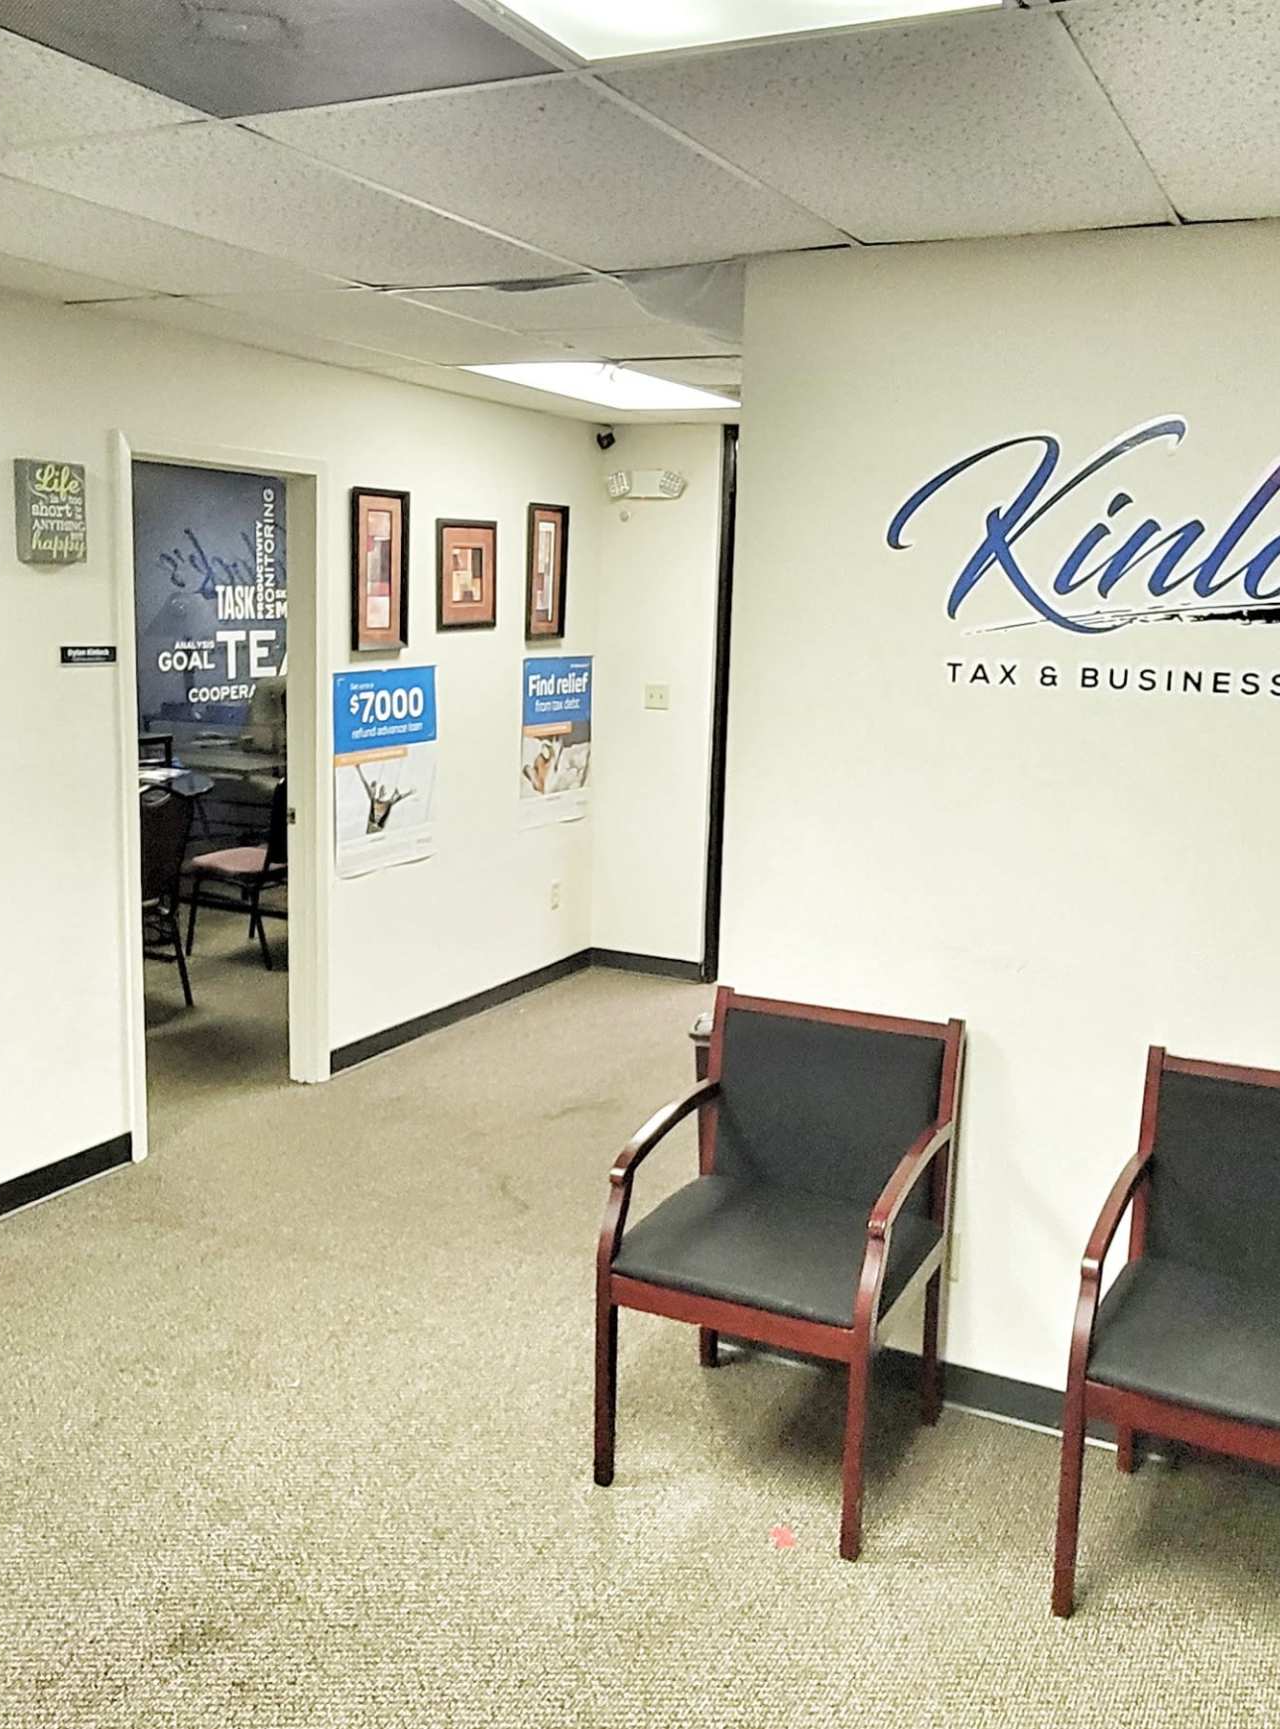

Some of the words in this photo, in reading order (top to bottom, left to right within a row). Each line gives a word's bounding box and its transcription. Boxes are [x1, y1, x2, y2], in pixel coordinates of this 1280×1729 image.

[35, 464, 80, 499] Life
[32, 500, 72, 517] short
[32, 519, 86, 532] ANYTHING
[32, 530, 85, 558] happy
[263, 488, 275, 619] MONITORING
[255, 520, 264, 619] PRODUCTIVITY
[215, 585, 255, 620] TASK
[174, 640, 215, 649] ANALYSIS
[158, 651, 216, 671] GOAL
[947, 661, 1018, 686] TAX
[1039, 666, 1058, 686] &
[528, 673, 555, 696] Find
[556, 671, 588, 694] relief
[350, 687, 424, 723] $7,000
[351, 726, 376, 739] refund
[377, 724, 407, 736] advance
